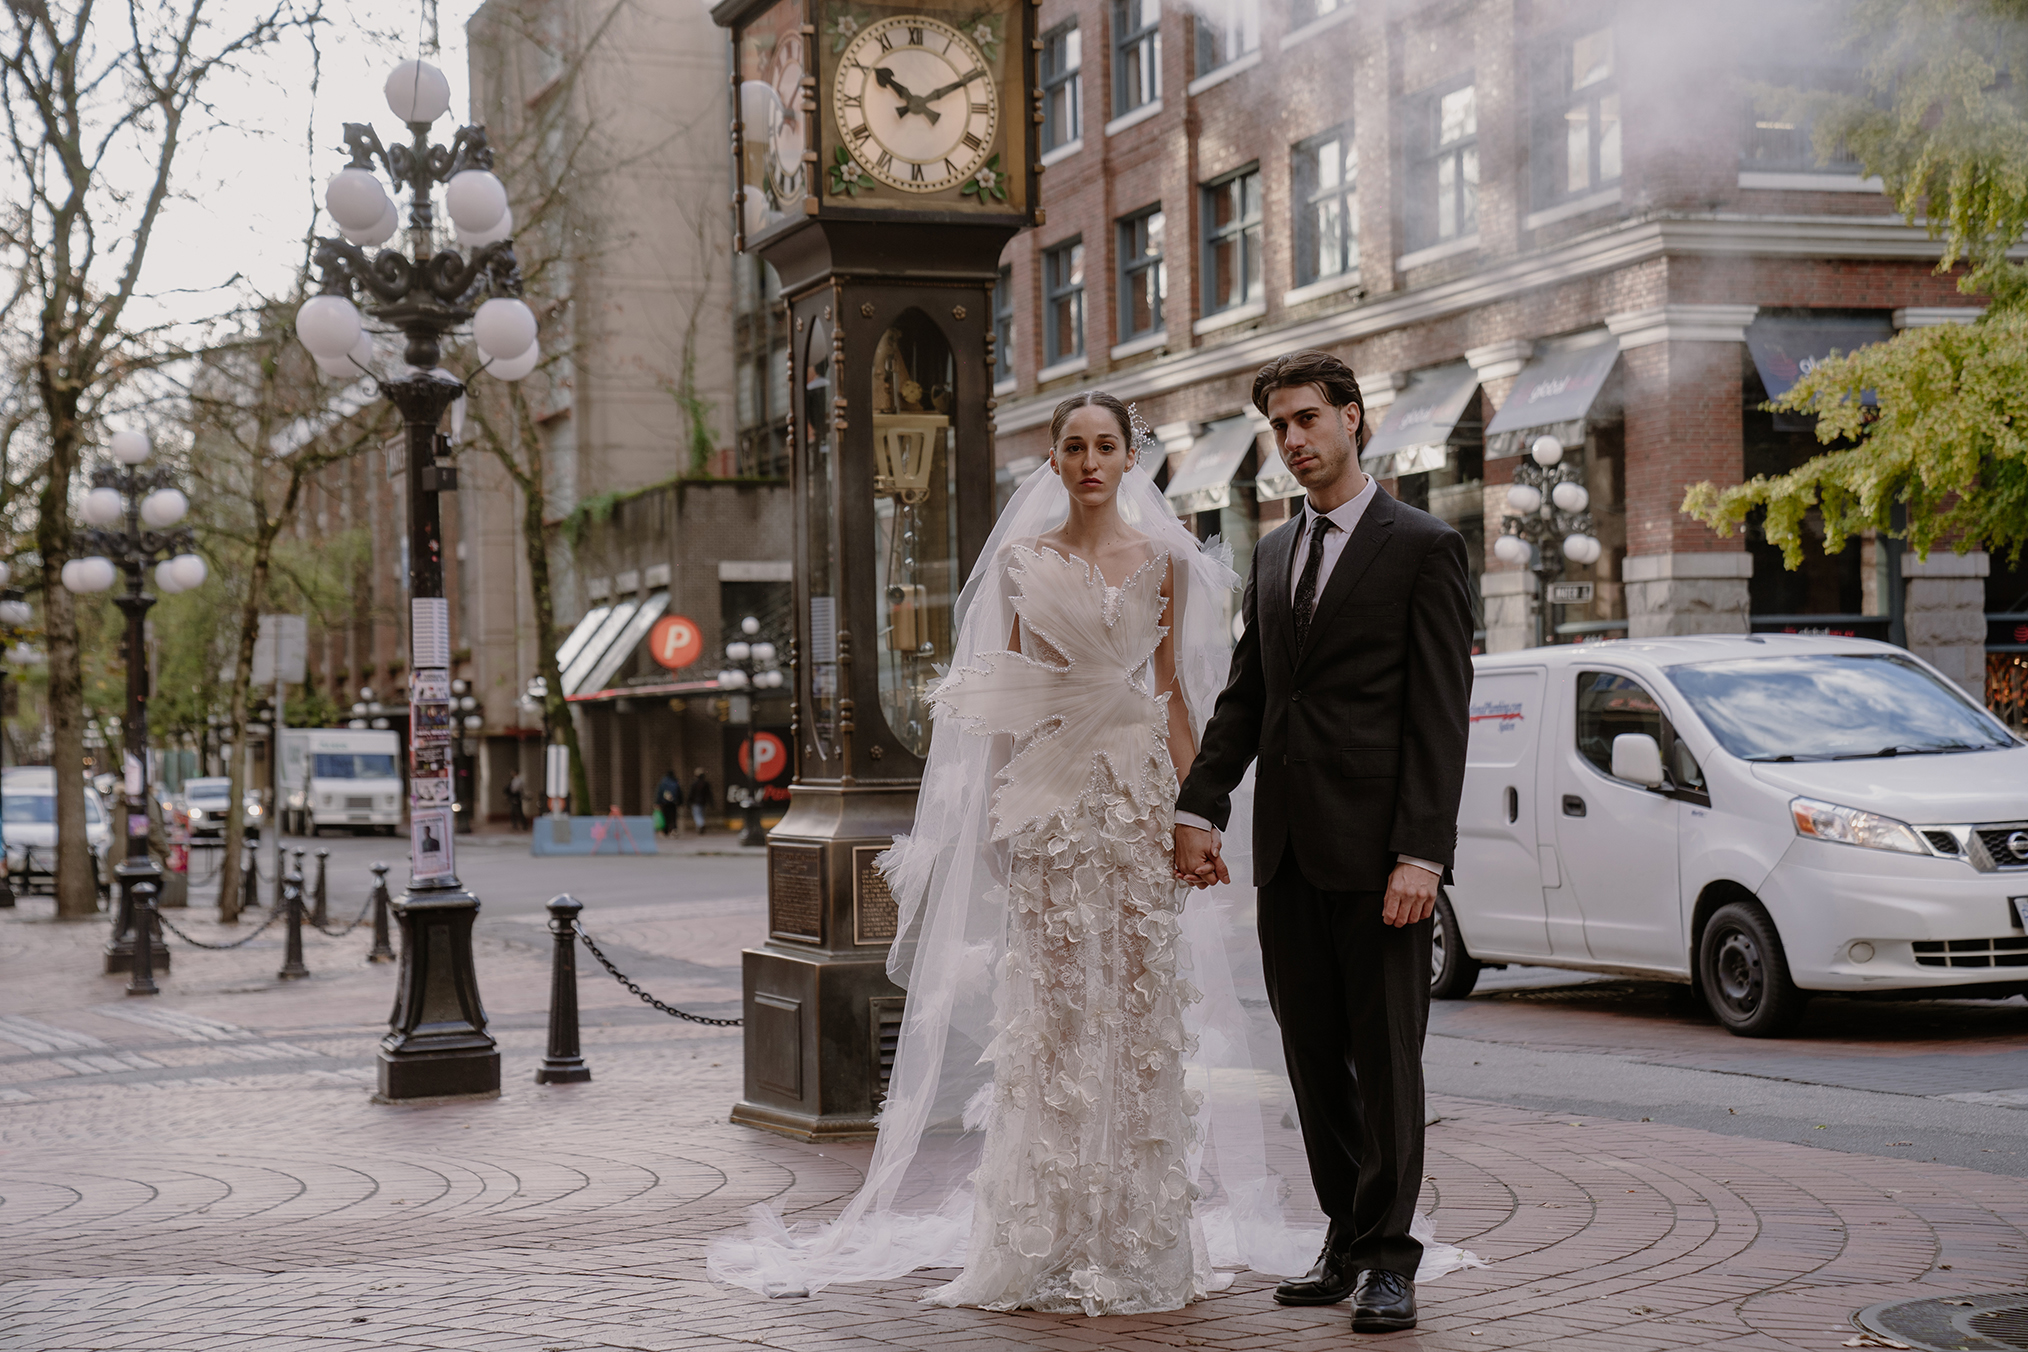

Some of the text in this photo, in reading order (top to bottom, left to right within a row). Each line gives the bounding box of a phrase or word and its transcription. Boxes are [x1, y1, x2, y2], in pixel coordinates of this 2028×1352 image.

[875, 32, 893, 54] XI
[908, 27, 923, 46] XII
[971, 103, 988, 114] III
[664, 624, 691, 660] P
[748, 739, 776, 776] P
